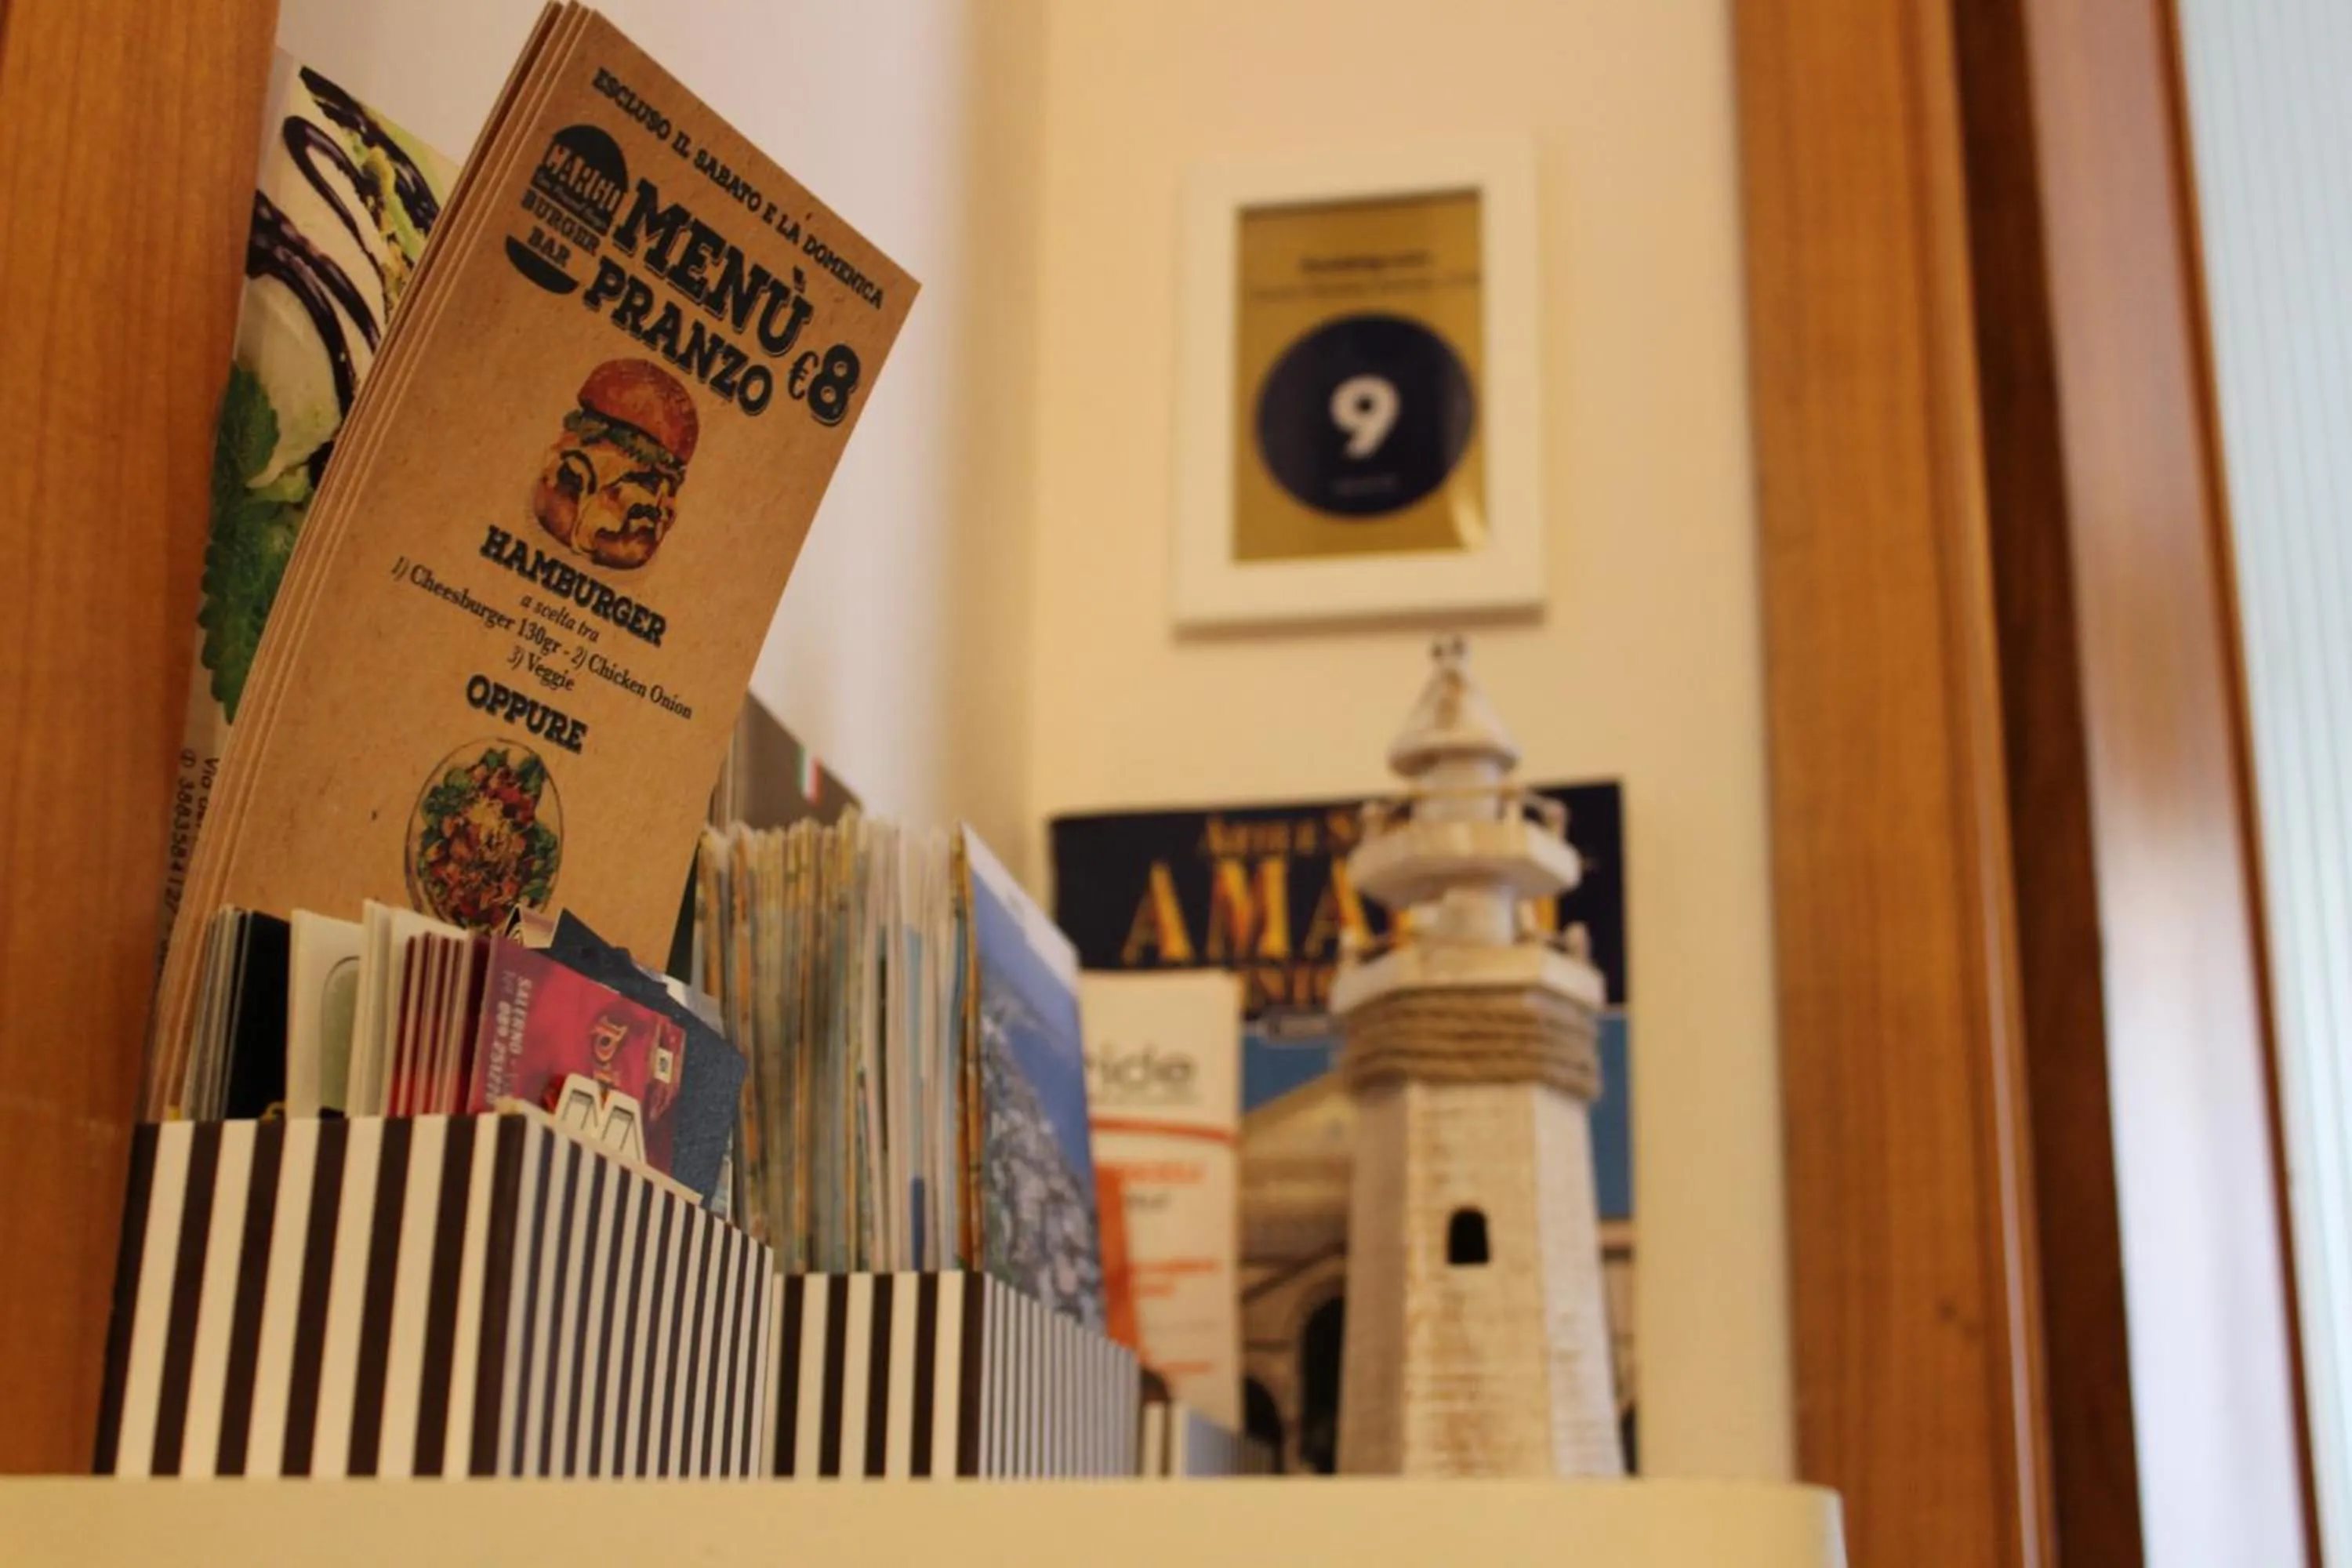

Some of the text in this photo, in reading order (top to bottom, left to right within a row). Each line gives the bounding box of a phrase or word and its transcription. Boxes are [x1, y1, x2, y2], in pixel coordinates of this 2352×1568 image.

[521, 187, 601, 257] BURGER
[591, 66, 884, 310] ESCLUSO IL SABATO E LA DOMENICA
[527, 224, 572, 268] BAR
[612, 177, 815, 358] MENÙ
[582, 256, 774, 417] PRANZO
[1329, 375, 1402, 461] 9
[479, 524, 668, 648] HAMBURGER
[533, 598, 578, 631] scelta
[577, 619, 600, 643] tra
[410, 564, 516, 630] Cheesburger
[517, 616, 562, 657] 130gr
[571, 645, 589, 670] 2)
[588, 653, 648, 699] Chicken
[649, 684, 693, 720] Onion
[506, 644, 576, 692] 3) Veggie
[466, 673, 590, 754] OPPURE
